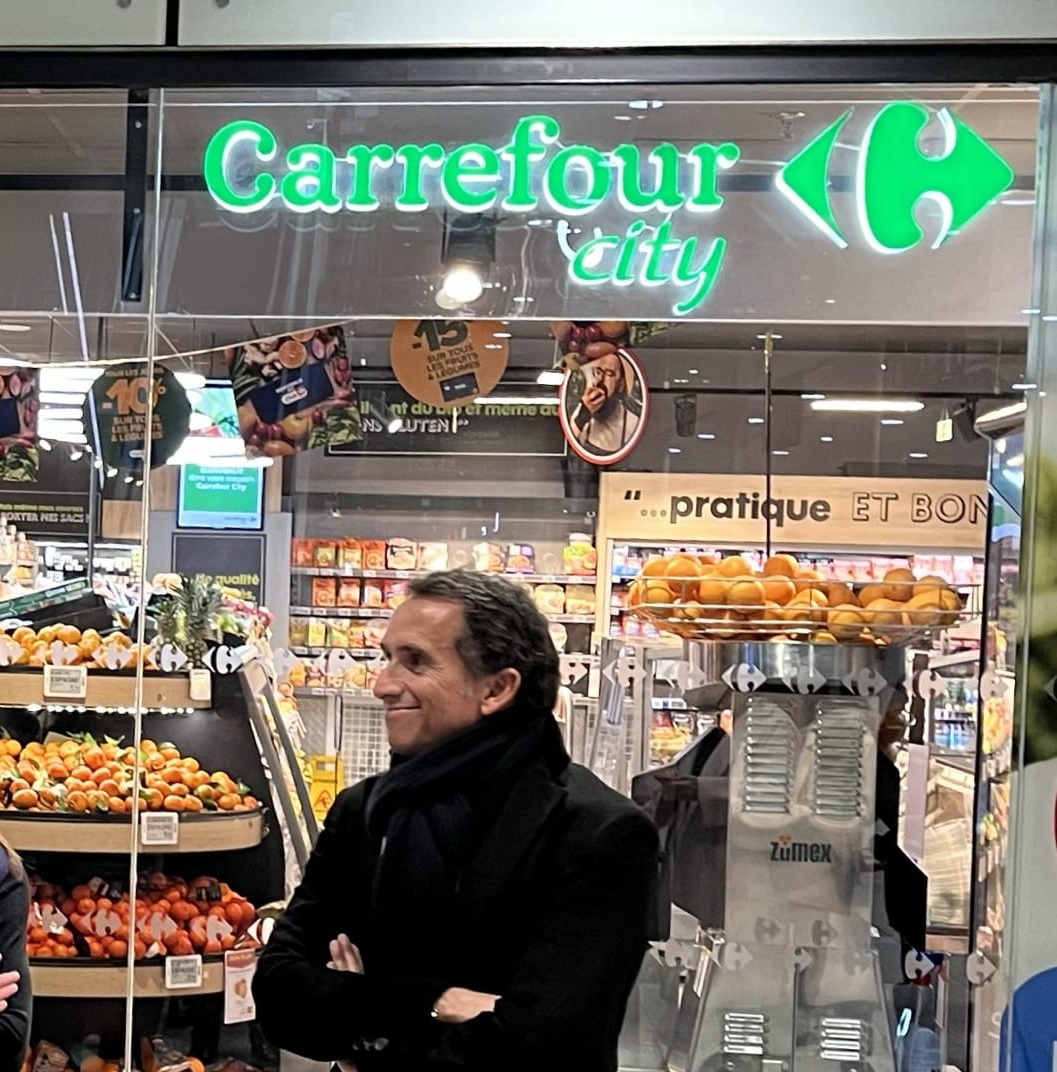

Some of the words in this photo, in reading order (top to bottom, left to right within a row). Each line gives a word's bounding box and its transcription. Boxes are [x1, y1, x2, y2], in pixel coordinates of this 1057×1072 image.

[203, 116, 740, 213] Carrefour
[569, 220, 727, 315] city
[449, 344, 474, 357] TOUS
[851, 492, 898, 521] ET
